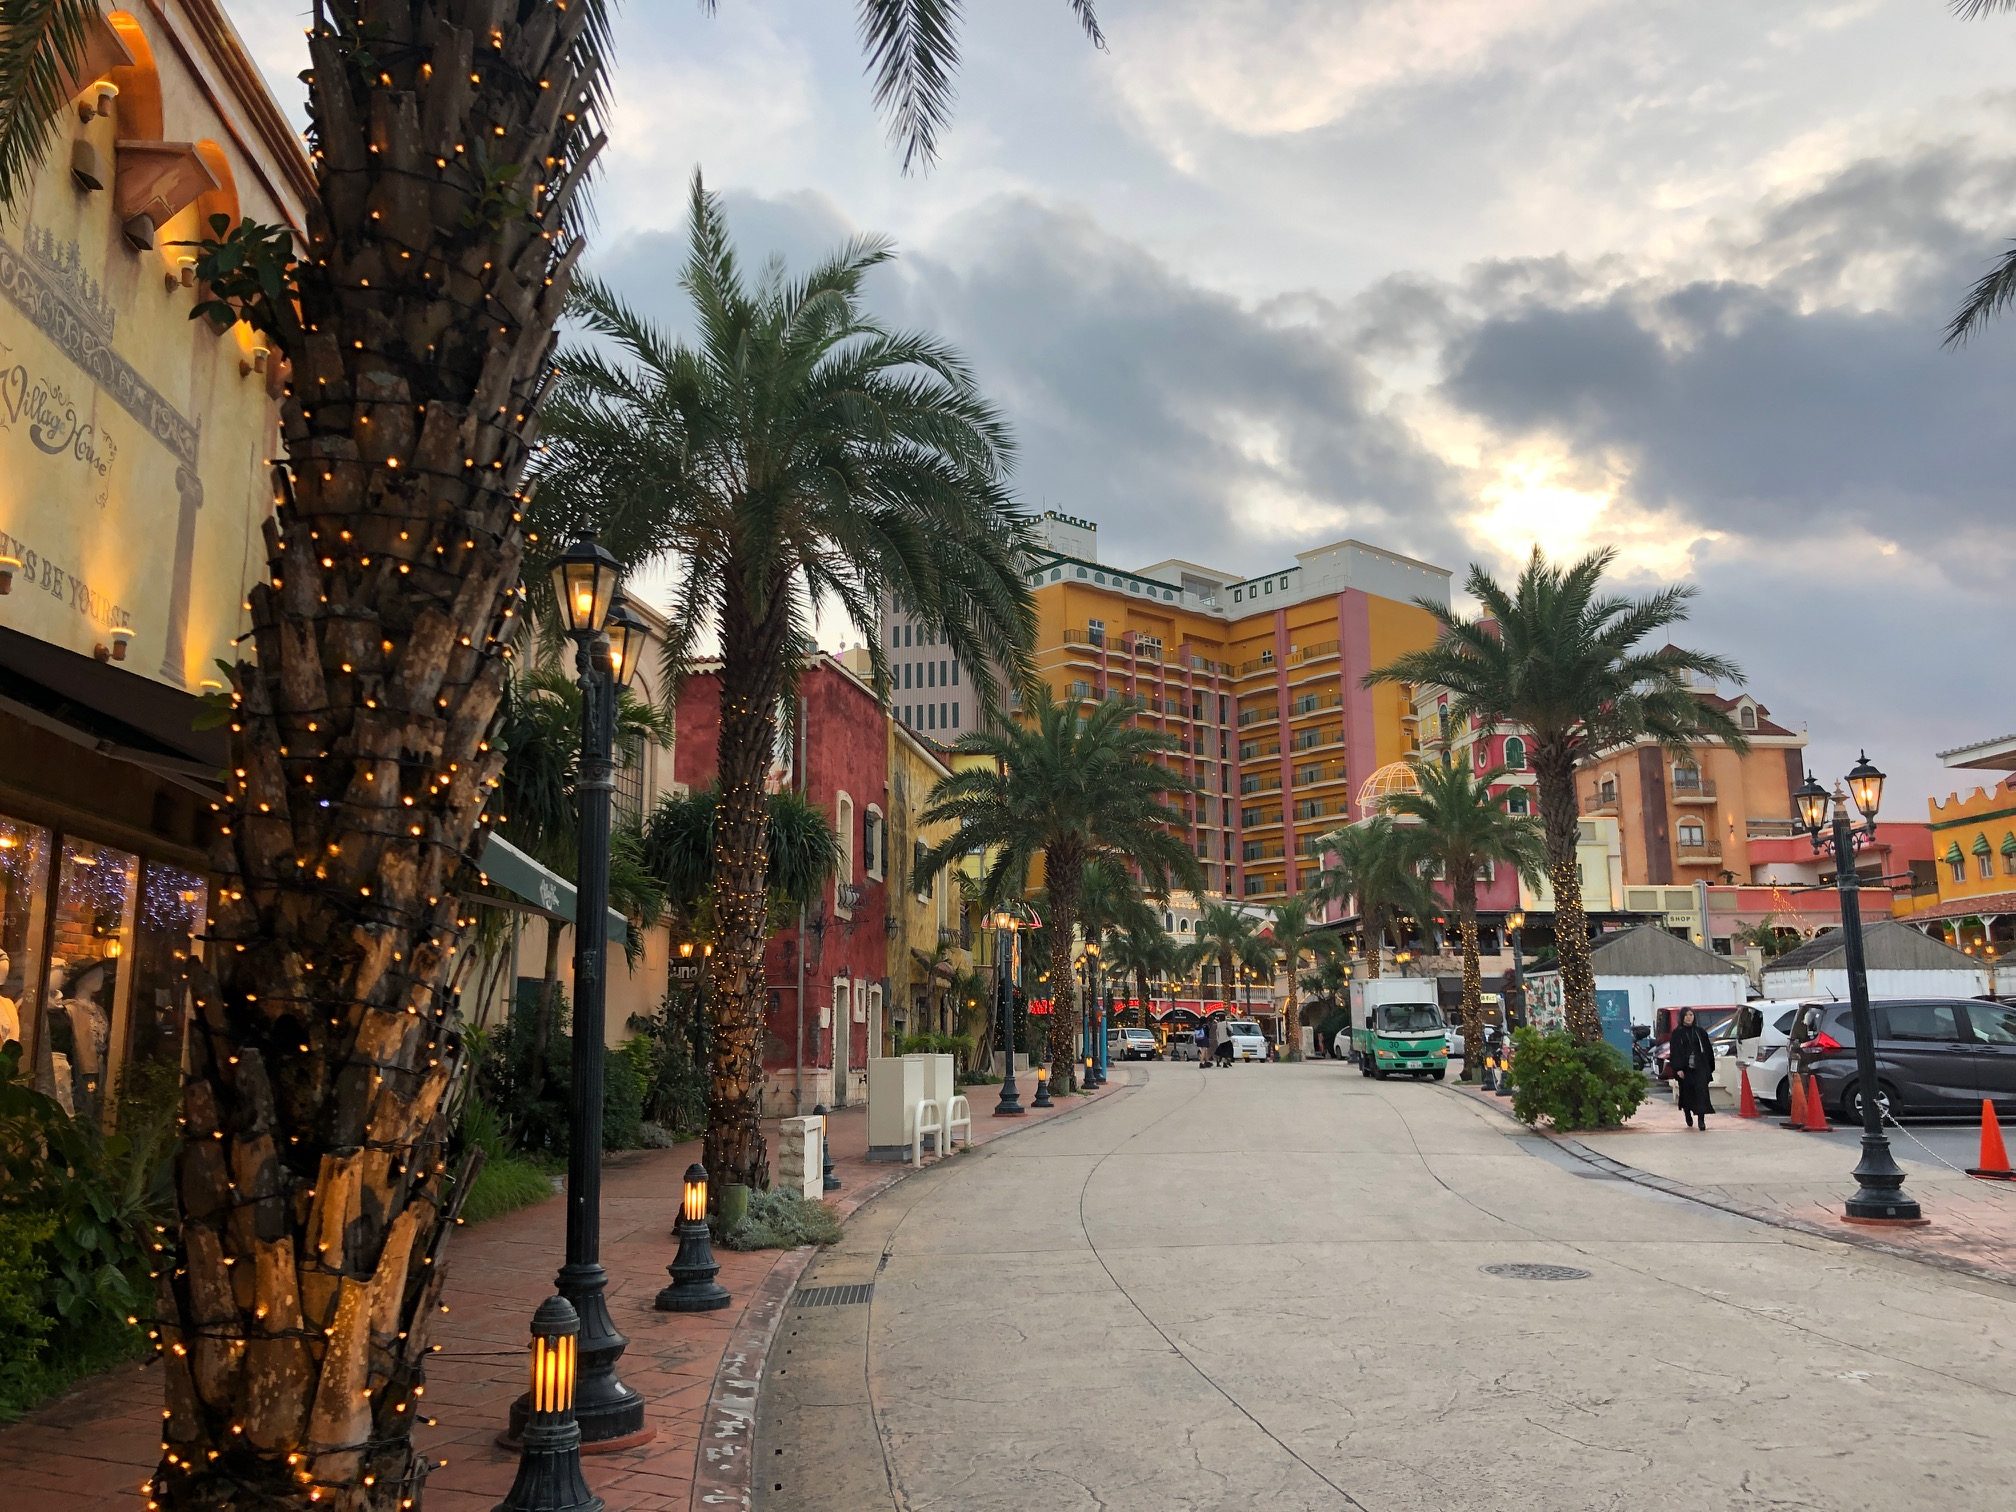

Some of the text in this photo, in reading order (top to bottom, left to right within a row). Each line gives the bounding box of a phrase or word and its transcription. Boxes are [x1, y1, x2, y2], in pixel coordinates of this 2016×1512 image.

[1, 365, 107, 476] Village House
[40, 557, 65, 600] BE
[1389, 1041, 1399, 1049] 30
